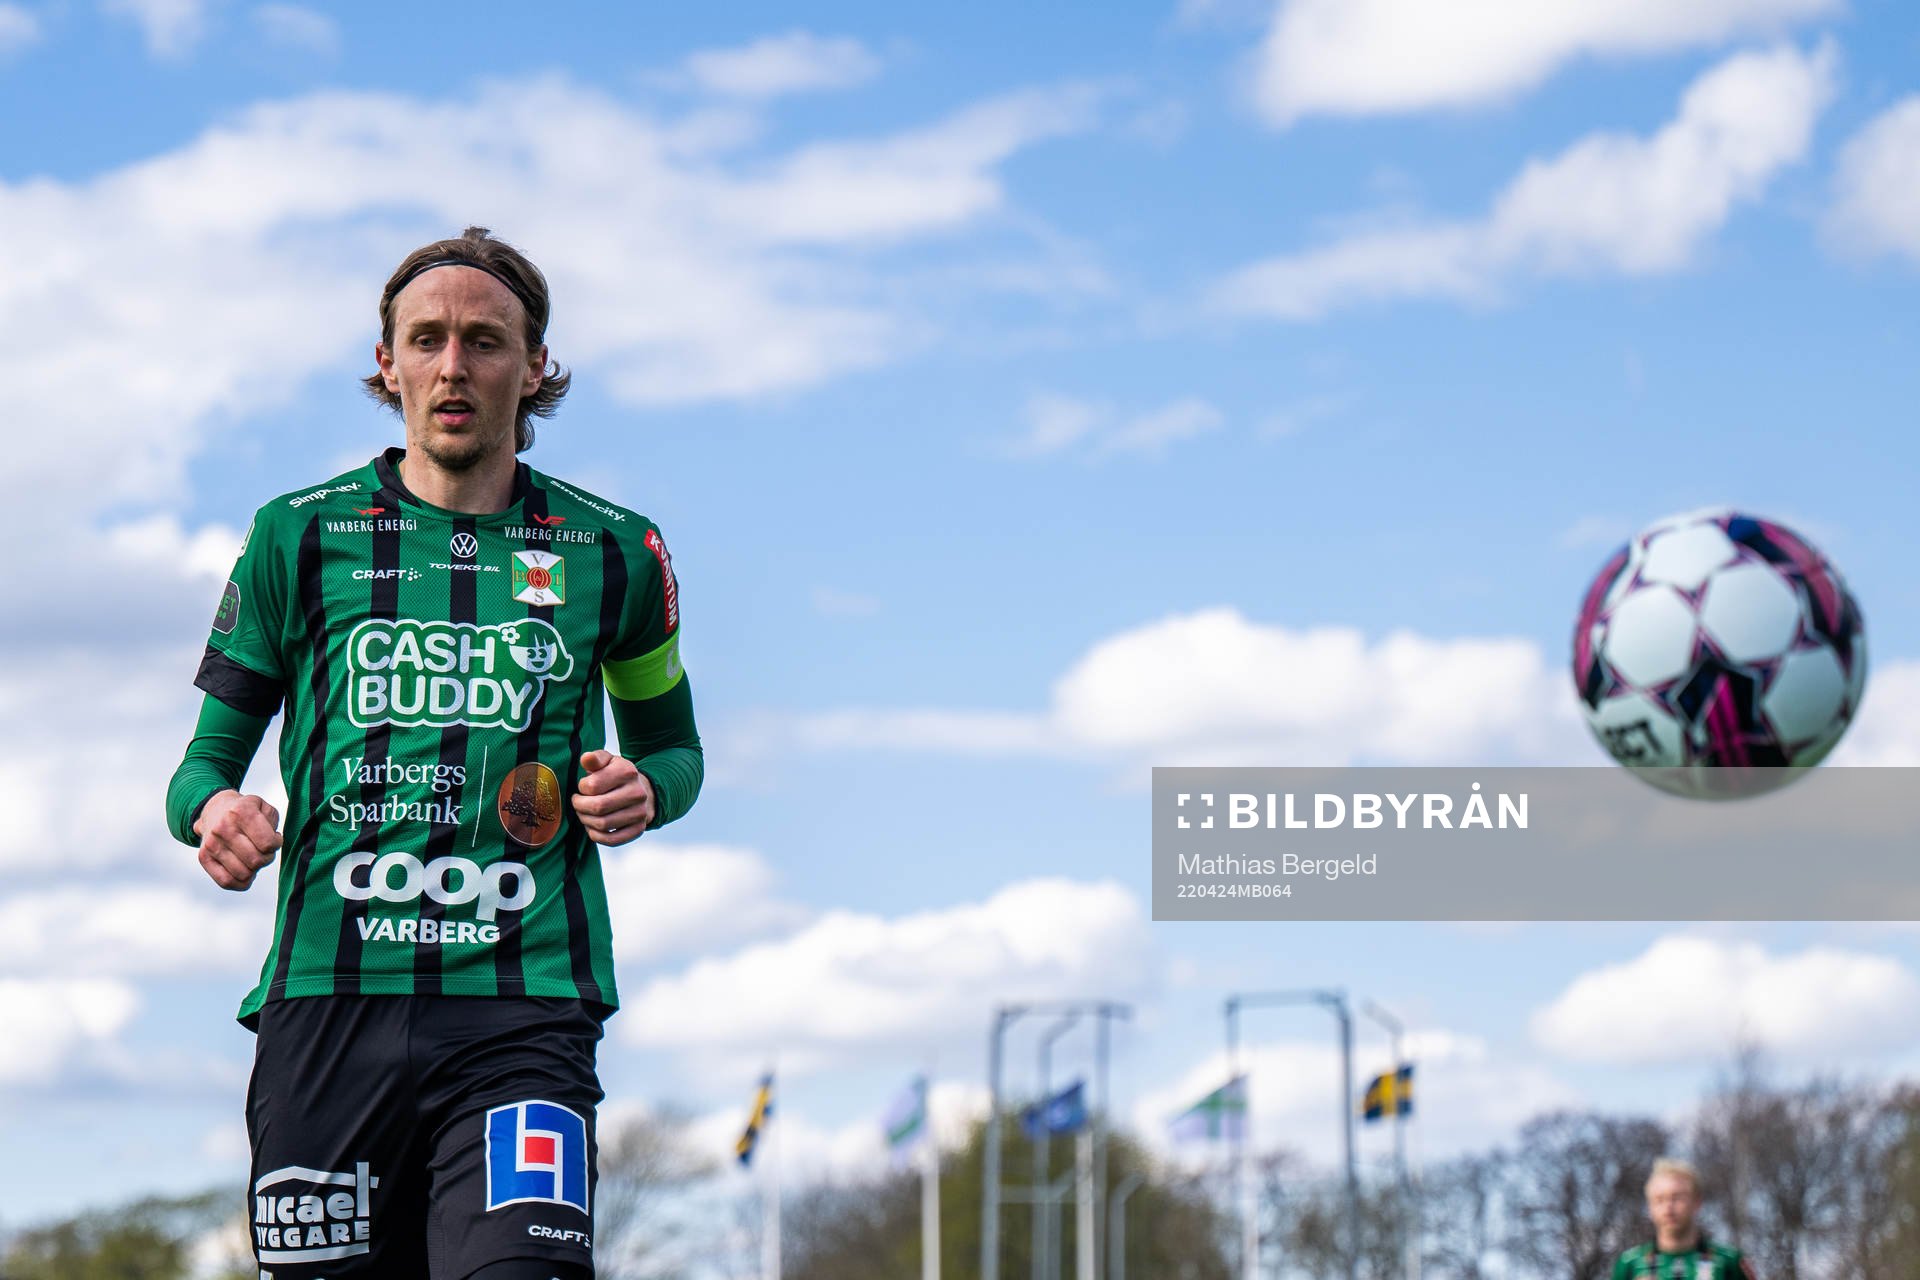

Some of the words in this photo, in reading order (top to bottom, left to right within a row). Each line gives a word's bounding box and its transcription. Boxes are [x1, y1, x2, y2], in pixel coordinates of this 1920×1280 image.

[326, 520, 374, 533] VARBERG
[378, 519, 417, 531] ENERGI
[504, 526, 552, 541] VARBERG
[556, 529, 596, 544] ENERGI
[352, 569, 407, 580] CRAFT
[429, 562, 482, 571] TOVEKS
[357, 630, 496, 674] CASH
[358, 674, 533, 720] BUDDY
[342, 756, 467, 792] Varbergs
[329, 794, 464, 831] Sparbank
[333, 851, 536, 922] coop
[356, 916, 501, 944] VARBERG
[256, 1220, 370, 1248] YGGARE
[528, 1224, 585, 1242] CRAFT
